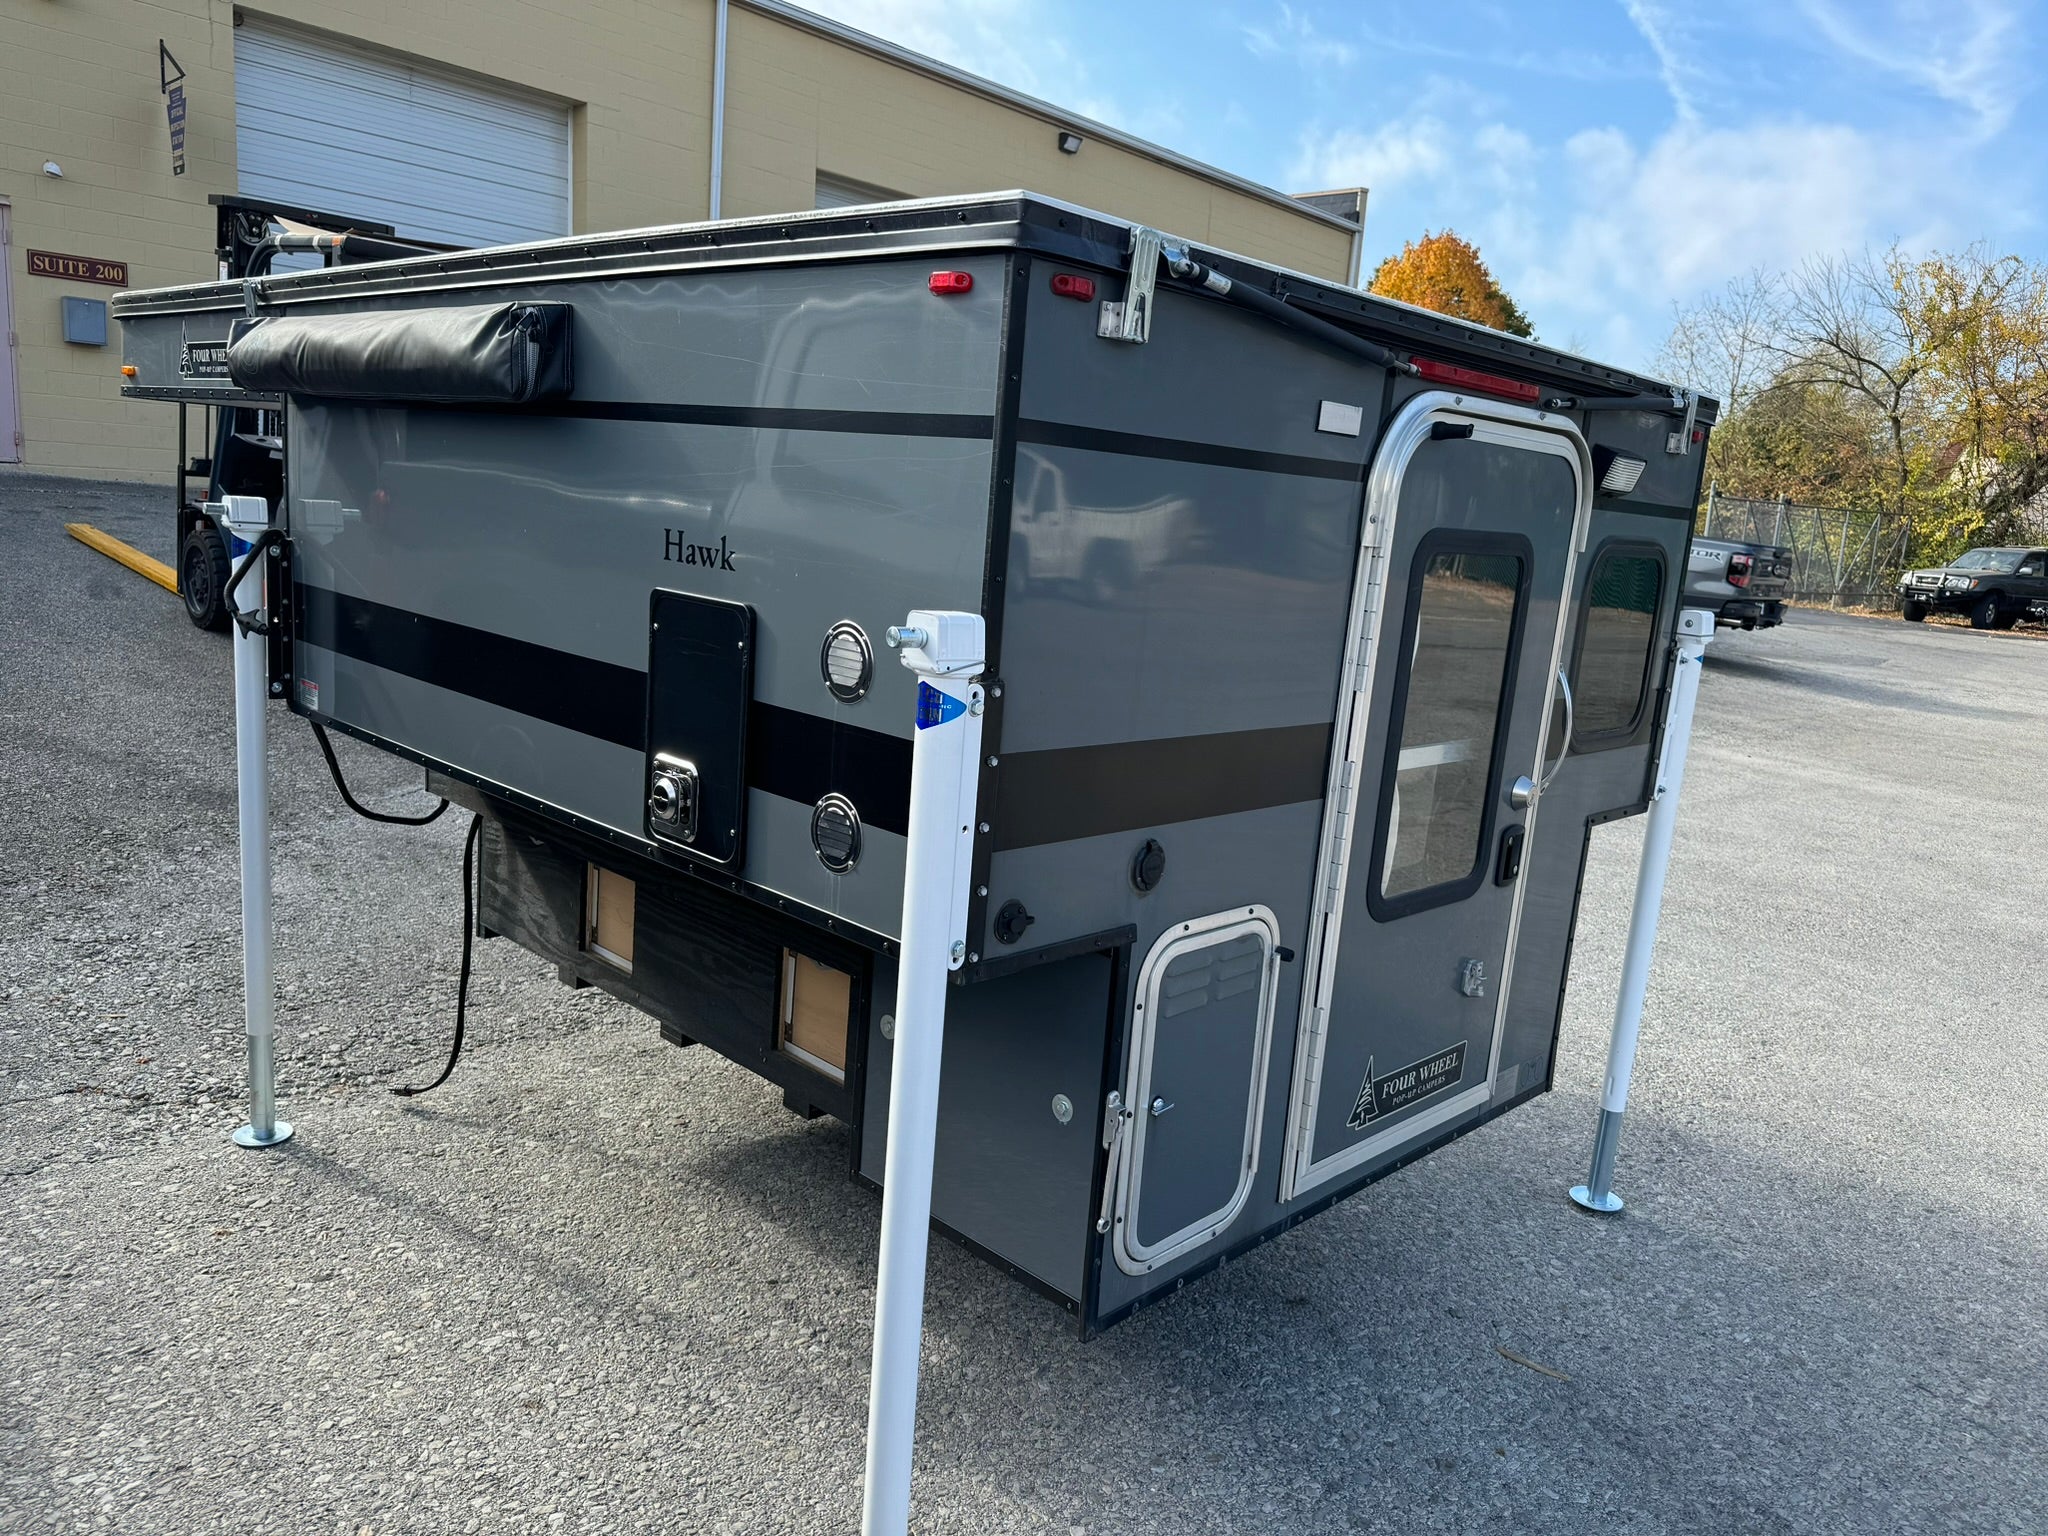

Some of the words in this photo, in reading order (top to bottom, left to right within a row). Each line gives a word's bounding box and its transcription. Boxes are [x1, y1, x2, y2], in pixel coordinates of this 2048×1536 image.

[33, 255, 90, 276] SUITE
[95, 265, 123, 281] 200
[192, 349, 210, 362] FOUR
[664, 528, 736, 571] Hawk
[1381, 1071, 1416, 1098] FOUR
[1420, 1052, 1458, 1080] WHEEL
[1392, 1088, 1416, 1105] POP-UP
[1418, 1075, 1446, 1094] CAMPERS
